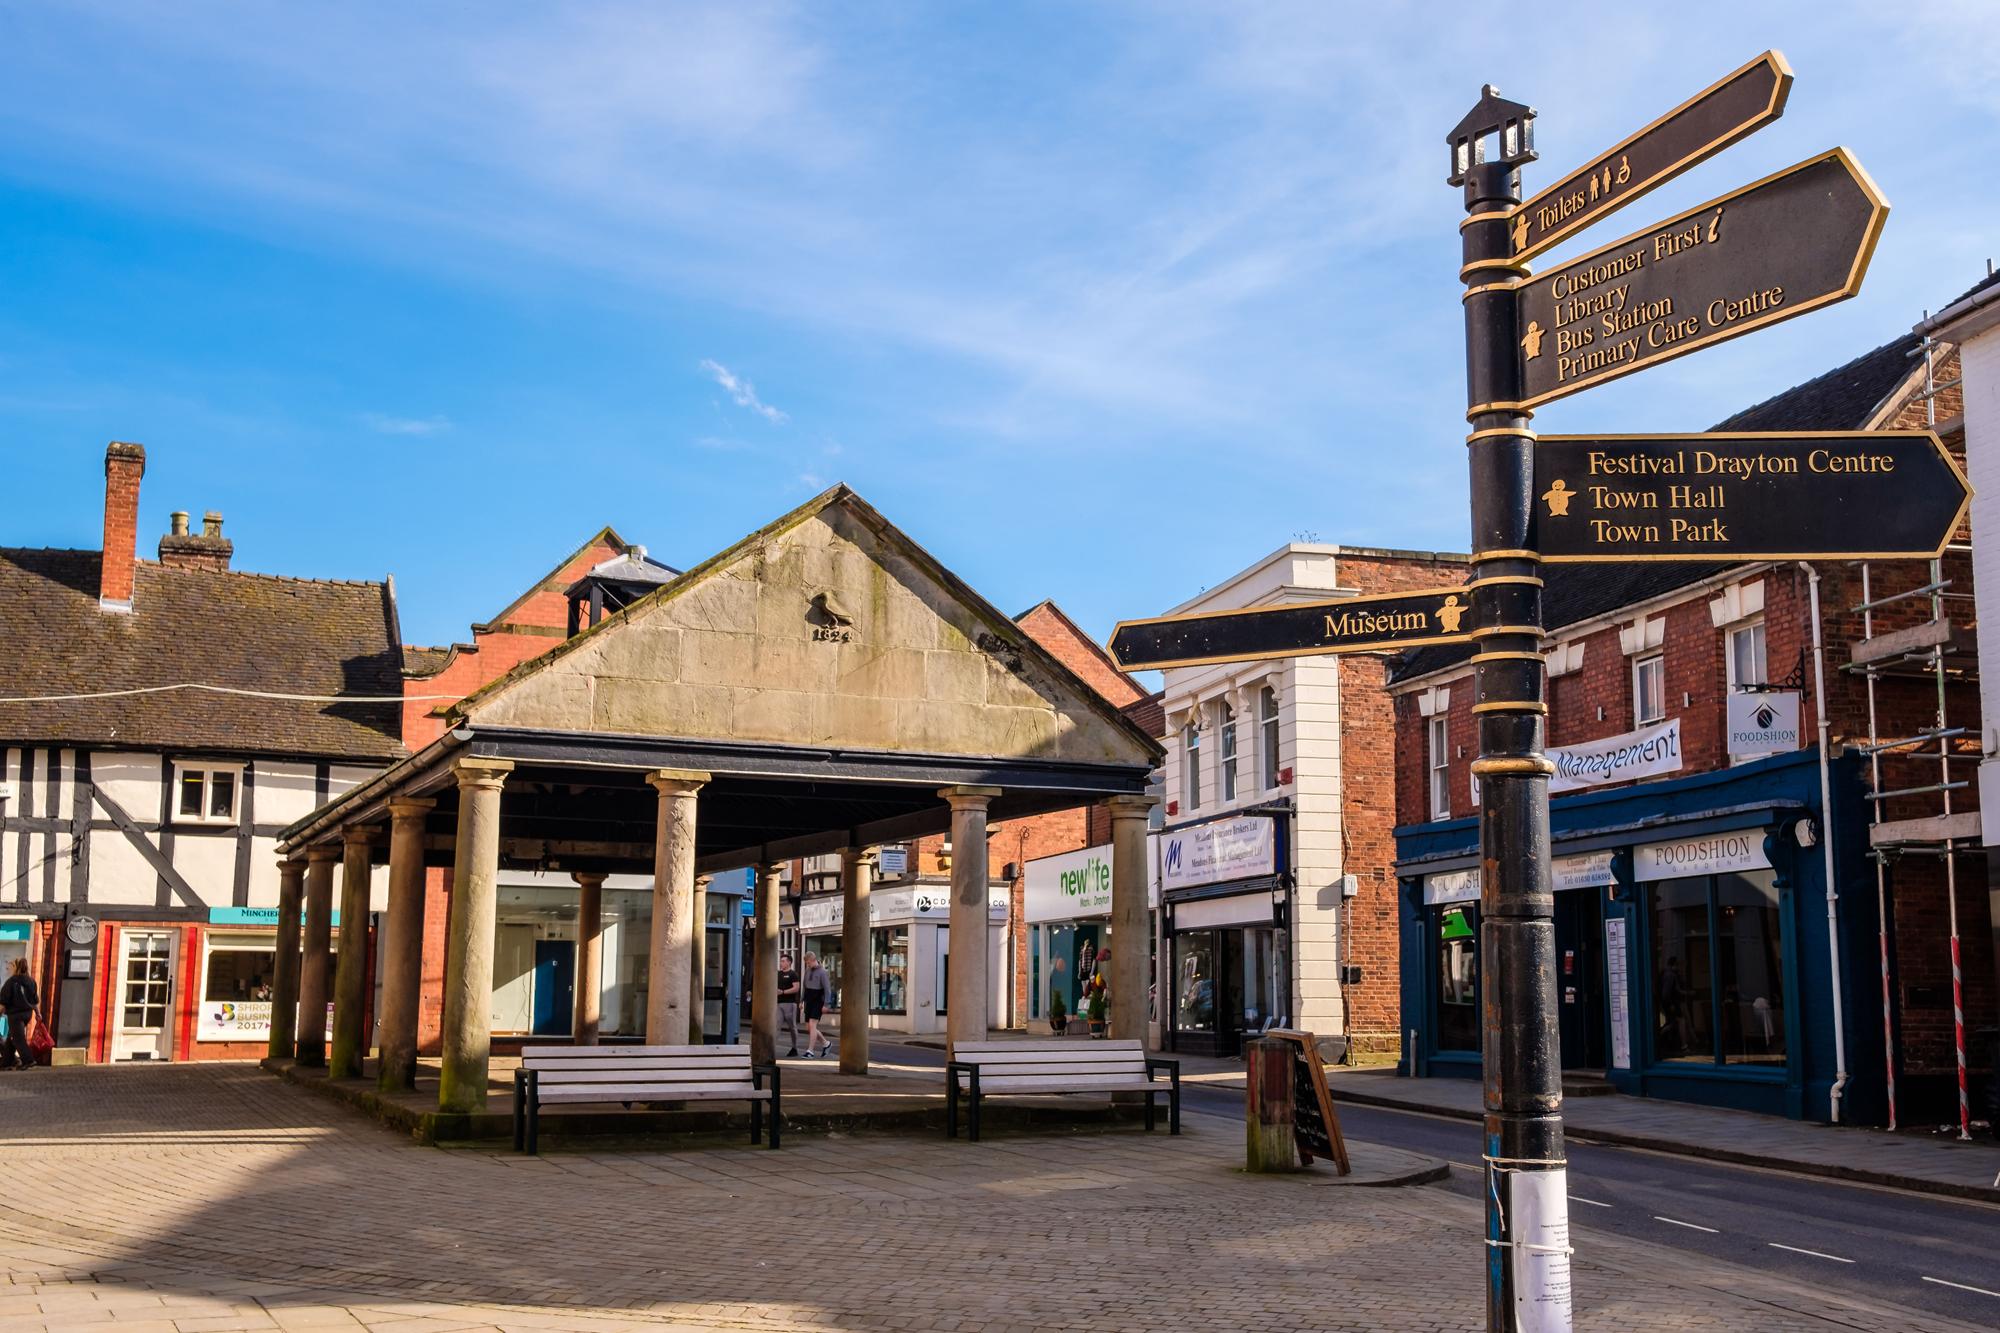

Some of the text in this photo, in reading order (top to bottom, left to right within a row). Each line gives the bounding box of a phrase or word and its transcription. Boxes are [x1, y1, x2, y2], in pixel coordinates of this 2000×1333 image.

[1536, 189, 1585, 232] Toilets
[1551, 249, 1646, 300] Customer
[1653, 223, 1702, 262] First
[1554, 284, 1630, 329] Library
[1556, 297, 1673, 356] Bus Station
[1558, 286, 1784, 382] Primary Care Centre
[1588, 449, 1895, 480] Festival Drayton Centre
[1588, 485, 1725, 509] Town Hall
[1590, 518, 1729, 543] Town Park
[1324, 611, 1428, 638] Museum
[1733, 730, 1796, 742] FOODSHION
[1557, 727, 1677, 779] Management
[1655, 836, 1750, 865] FOODSHION
[1060, 857, 1110, 896] newlife
[236, 1021, 264, 1030] 2017
[237, 1012, 271, 1021] BUSIN
